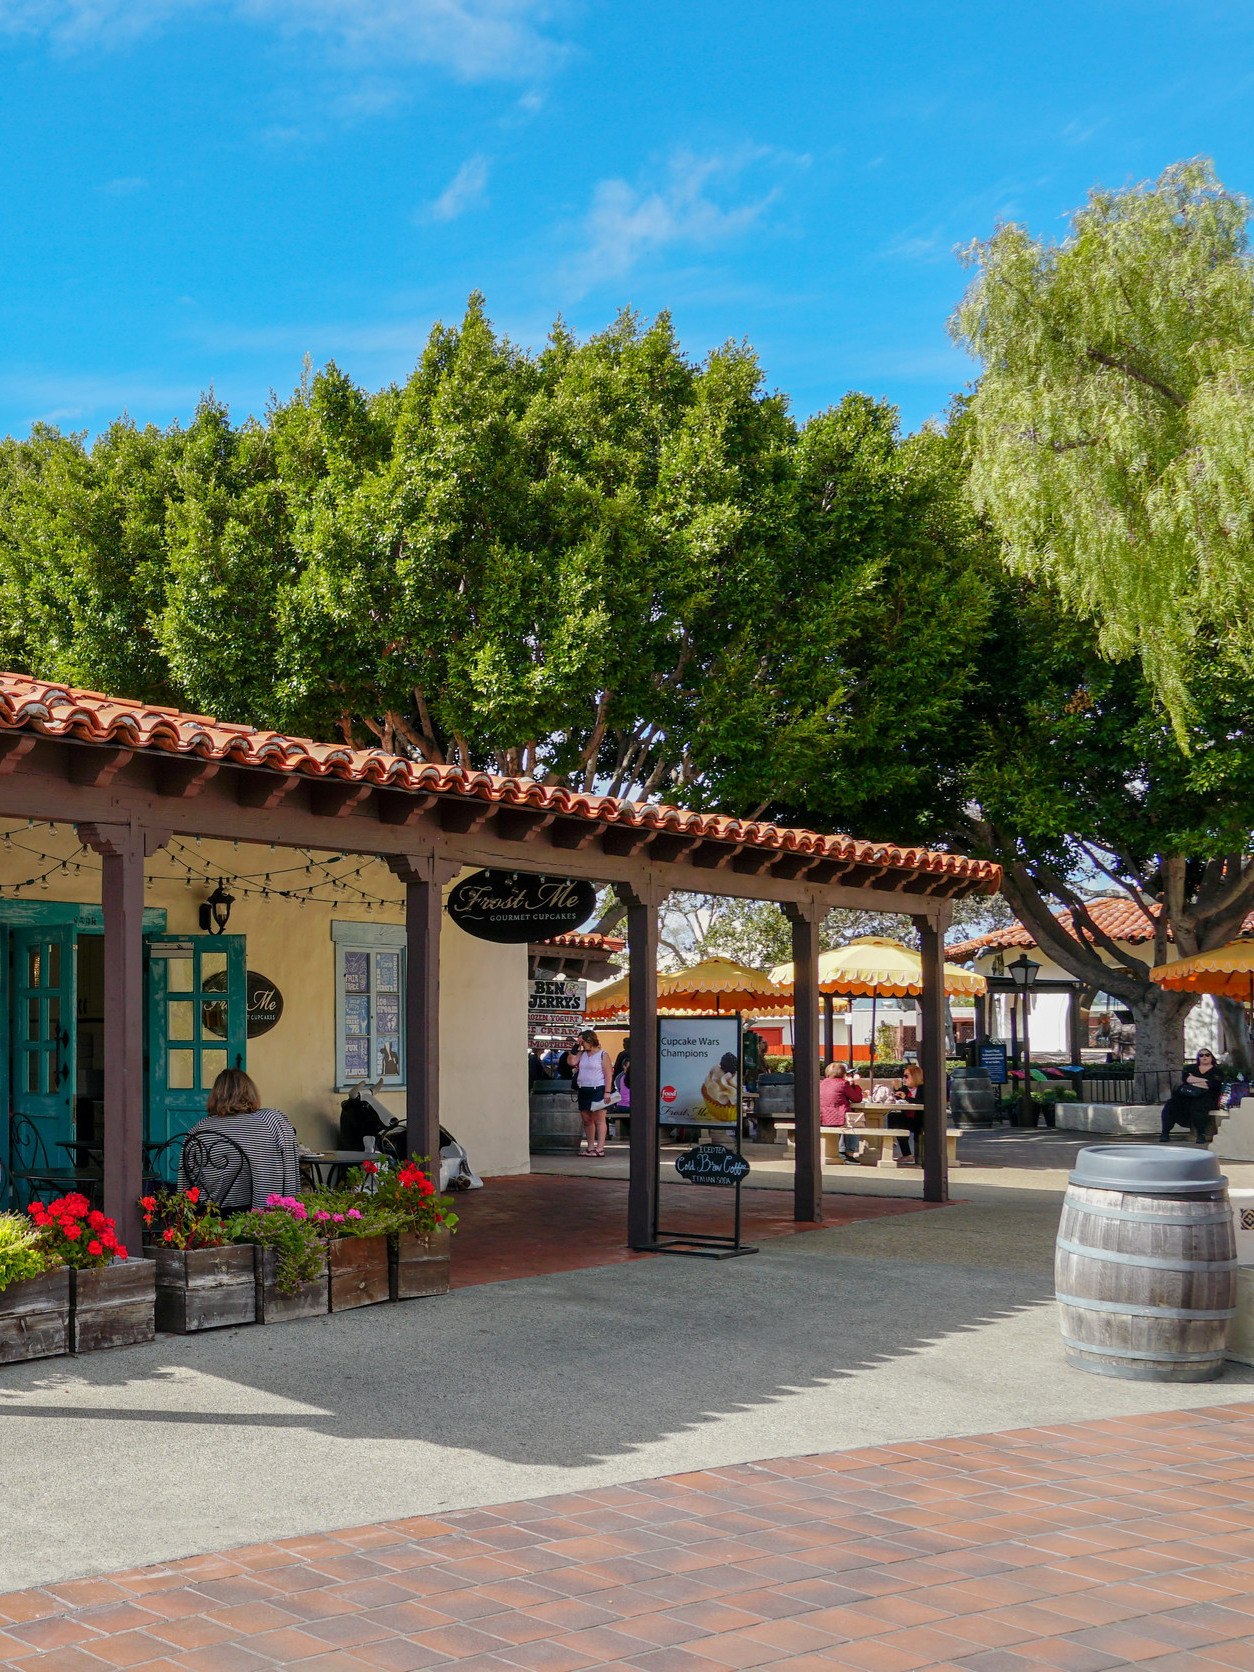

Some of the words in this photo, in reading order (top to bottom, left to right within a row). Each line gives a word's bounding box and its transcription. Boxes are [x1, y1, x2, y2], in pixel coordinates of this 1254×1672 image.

[454, 886, 527, 911] Frost
[525, 880, 579, 910] Me
[489, 914, 531, 922] GOURMET
[532, 913, 577, 921] CUPCAKES
[534, 981, 565, 995] BEN
[246, 989, 277, 1011] Me
[528, 994, 581, 1009] JERRY'S
[550, 1015, 579, 1023] YOGURT
[541, 1027, 579, 1036] CREAM
[660, 1037, 697, 1047] Cupcake
[699, 1037, 720, 1046] Wars
[660, 1048, 708, 1059] Champions
[661, 1089, 677, 1098] food
[677, 1156, 696, 1172] Cold
[723, 1155, 749, 1176] Coffee
[692, 1175, 716, 1184] ITALIAN
